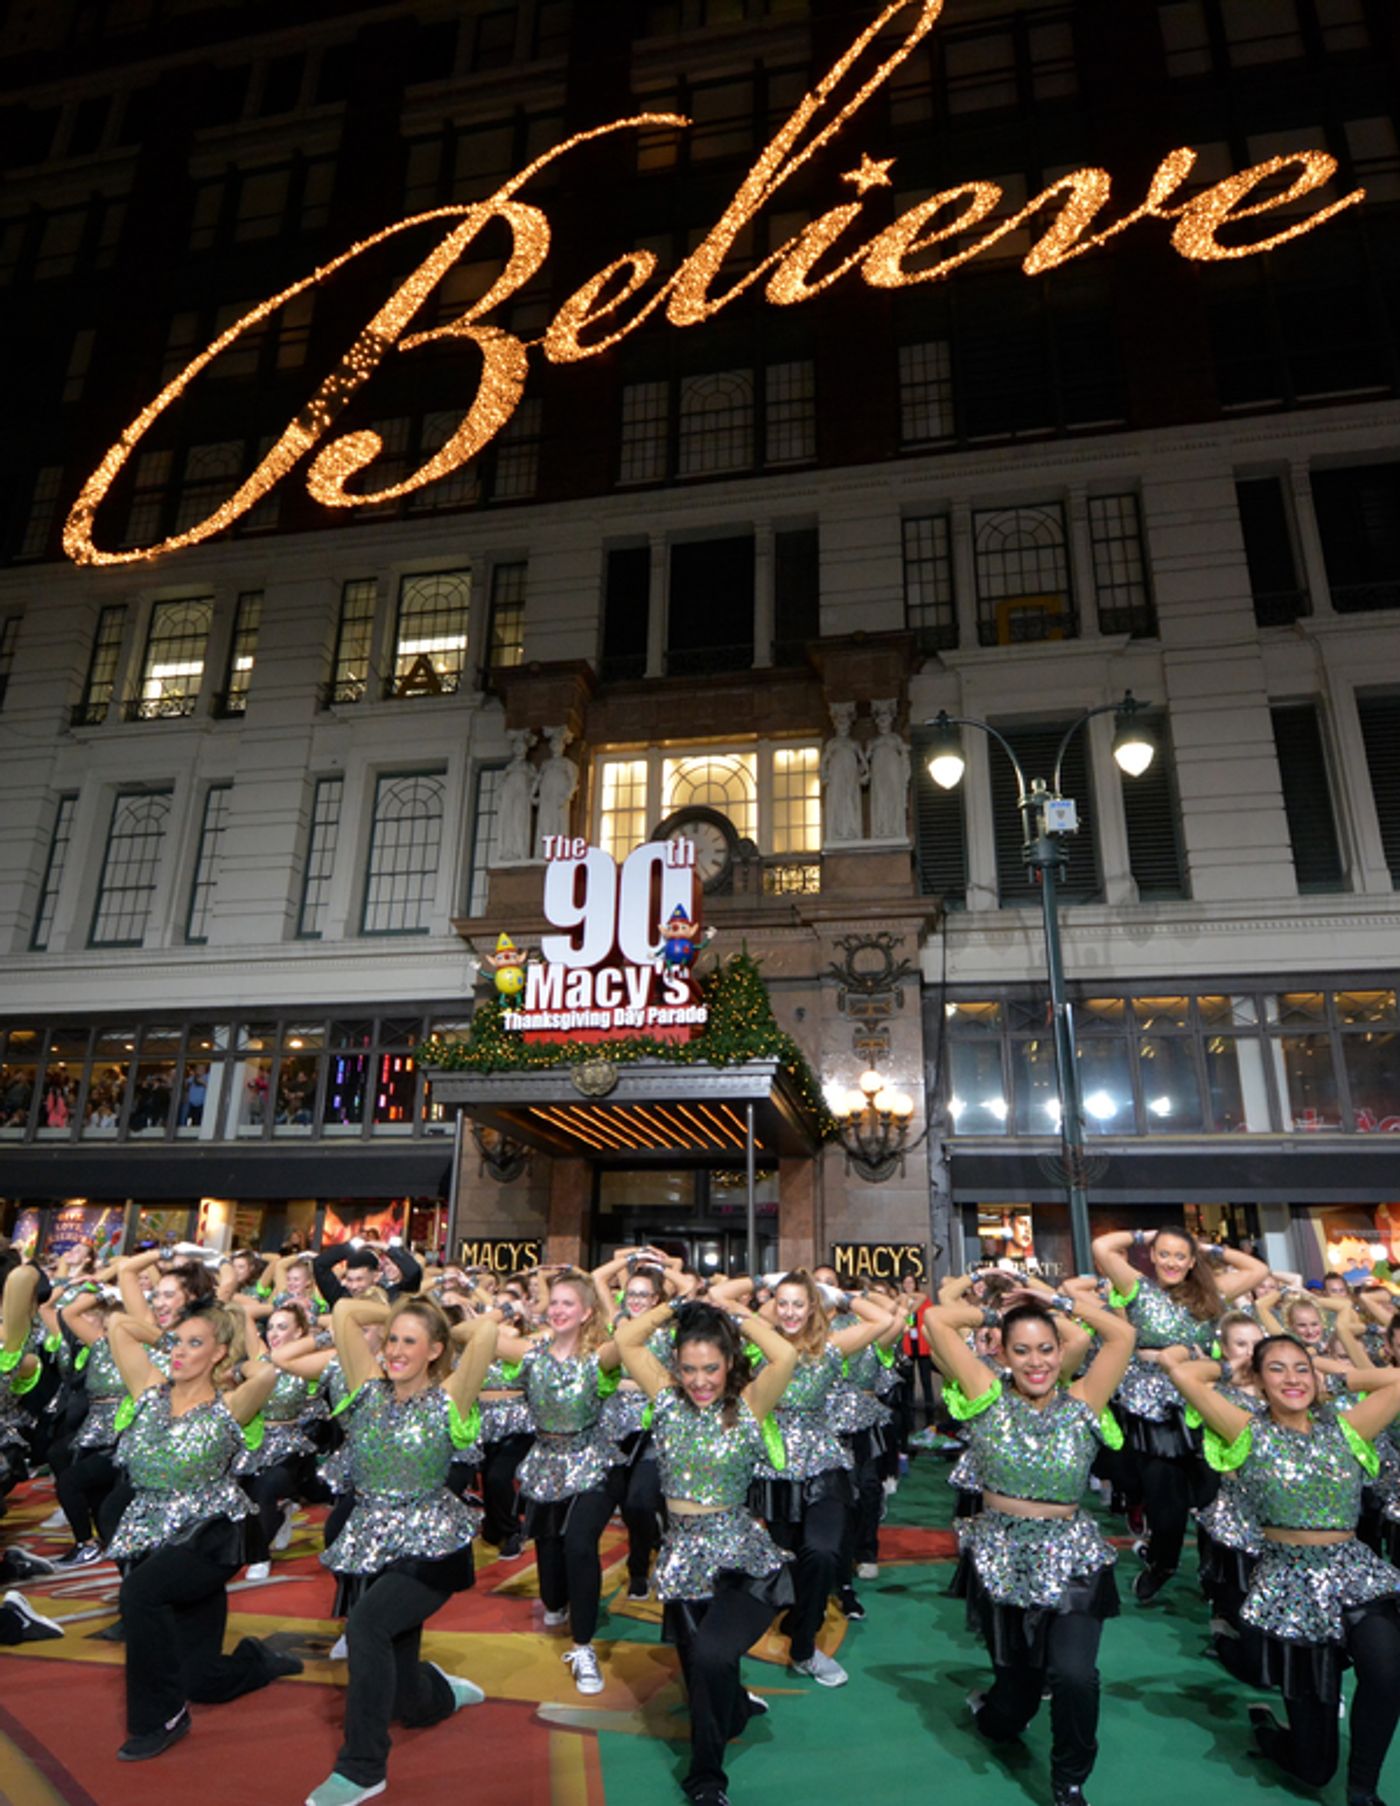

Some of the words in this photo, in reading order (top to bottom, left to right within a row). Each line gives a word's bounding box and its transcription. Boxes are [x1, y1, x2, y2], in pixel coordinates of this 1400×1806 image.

[61, 0, 1366, 567] Believe
[541, 835, 587, 862] The
[525, 958, 691, 1013] Macy's
[503, 1011, 611, 1031] Thanksgiving
[613, 1007, 645, 1026] Day
[647, 1003, 707, 1024] Parade
[834, 1245, 924, 1278] MACY'S
